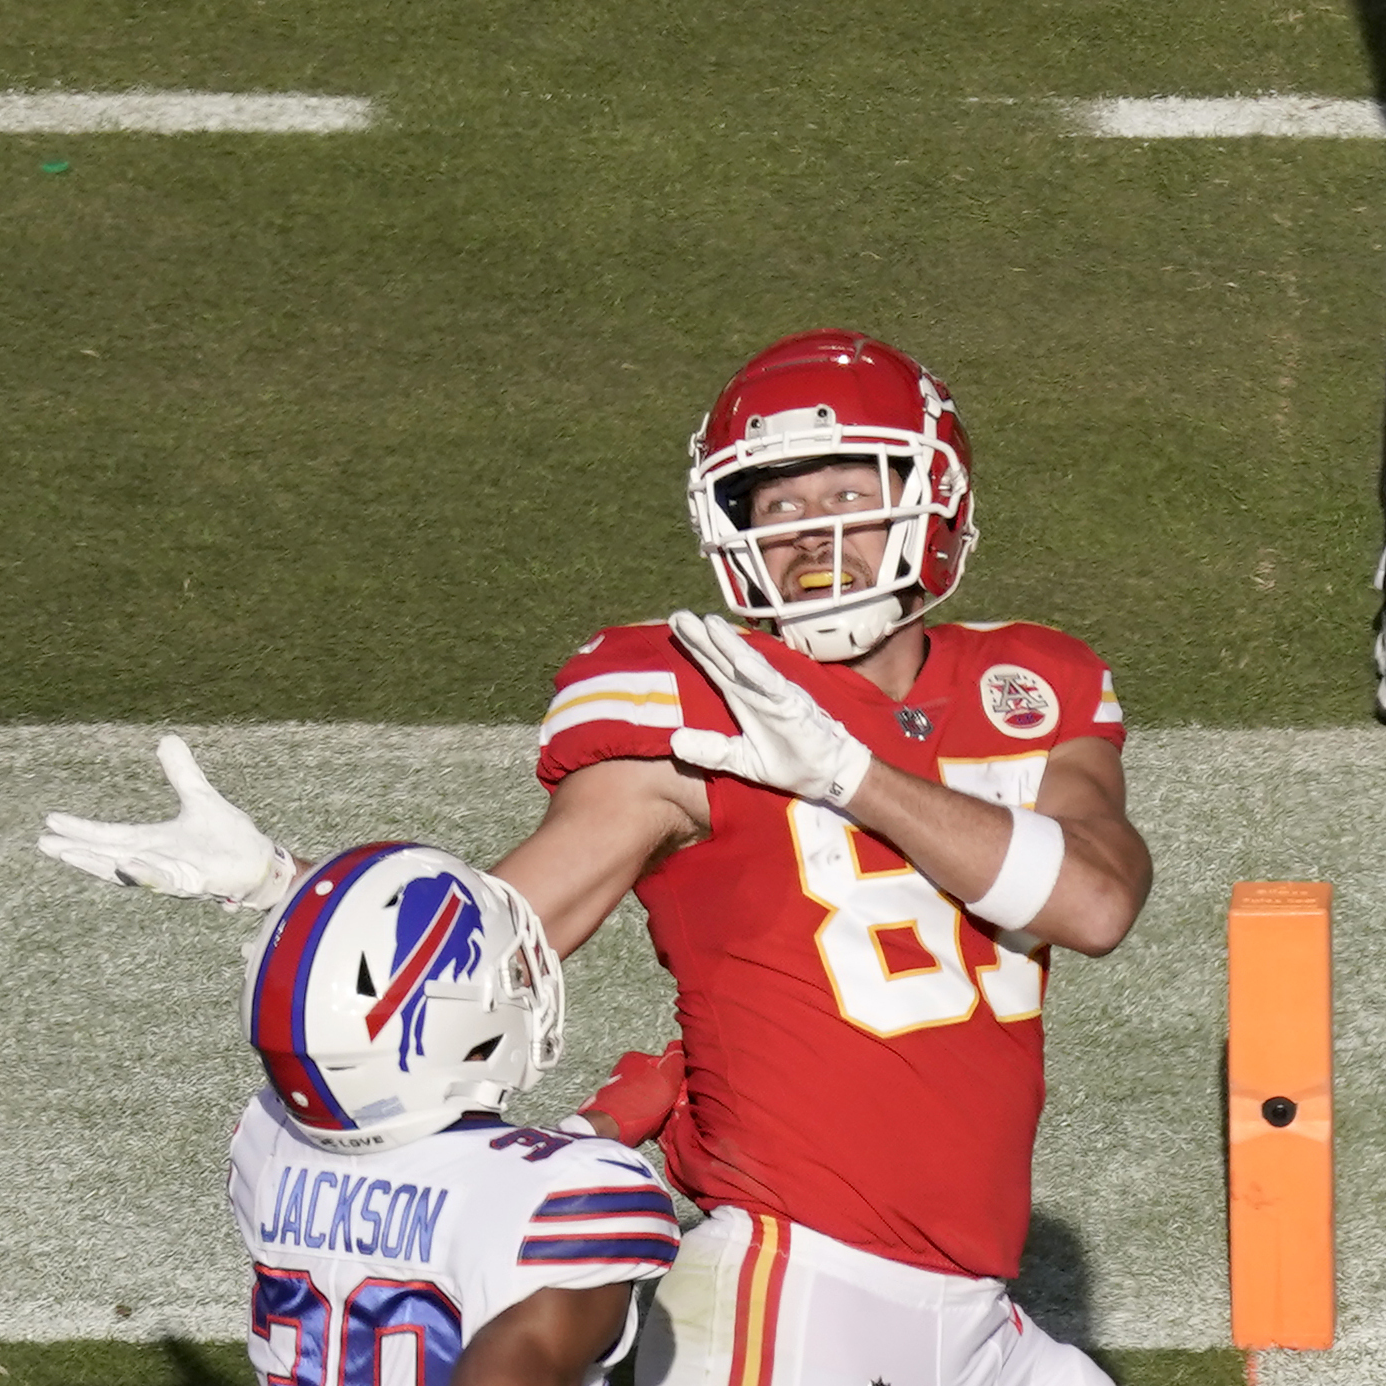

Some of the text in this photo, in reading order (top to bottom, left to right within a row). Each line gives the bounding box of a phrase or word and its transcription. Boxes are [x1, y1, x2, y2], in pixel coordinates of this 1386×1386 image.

[829, 780, 845, 797] 87
[338, 1135, 385, 1149] LOVE
[260, 1166, 449, 1263] JACKSON
